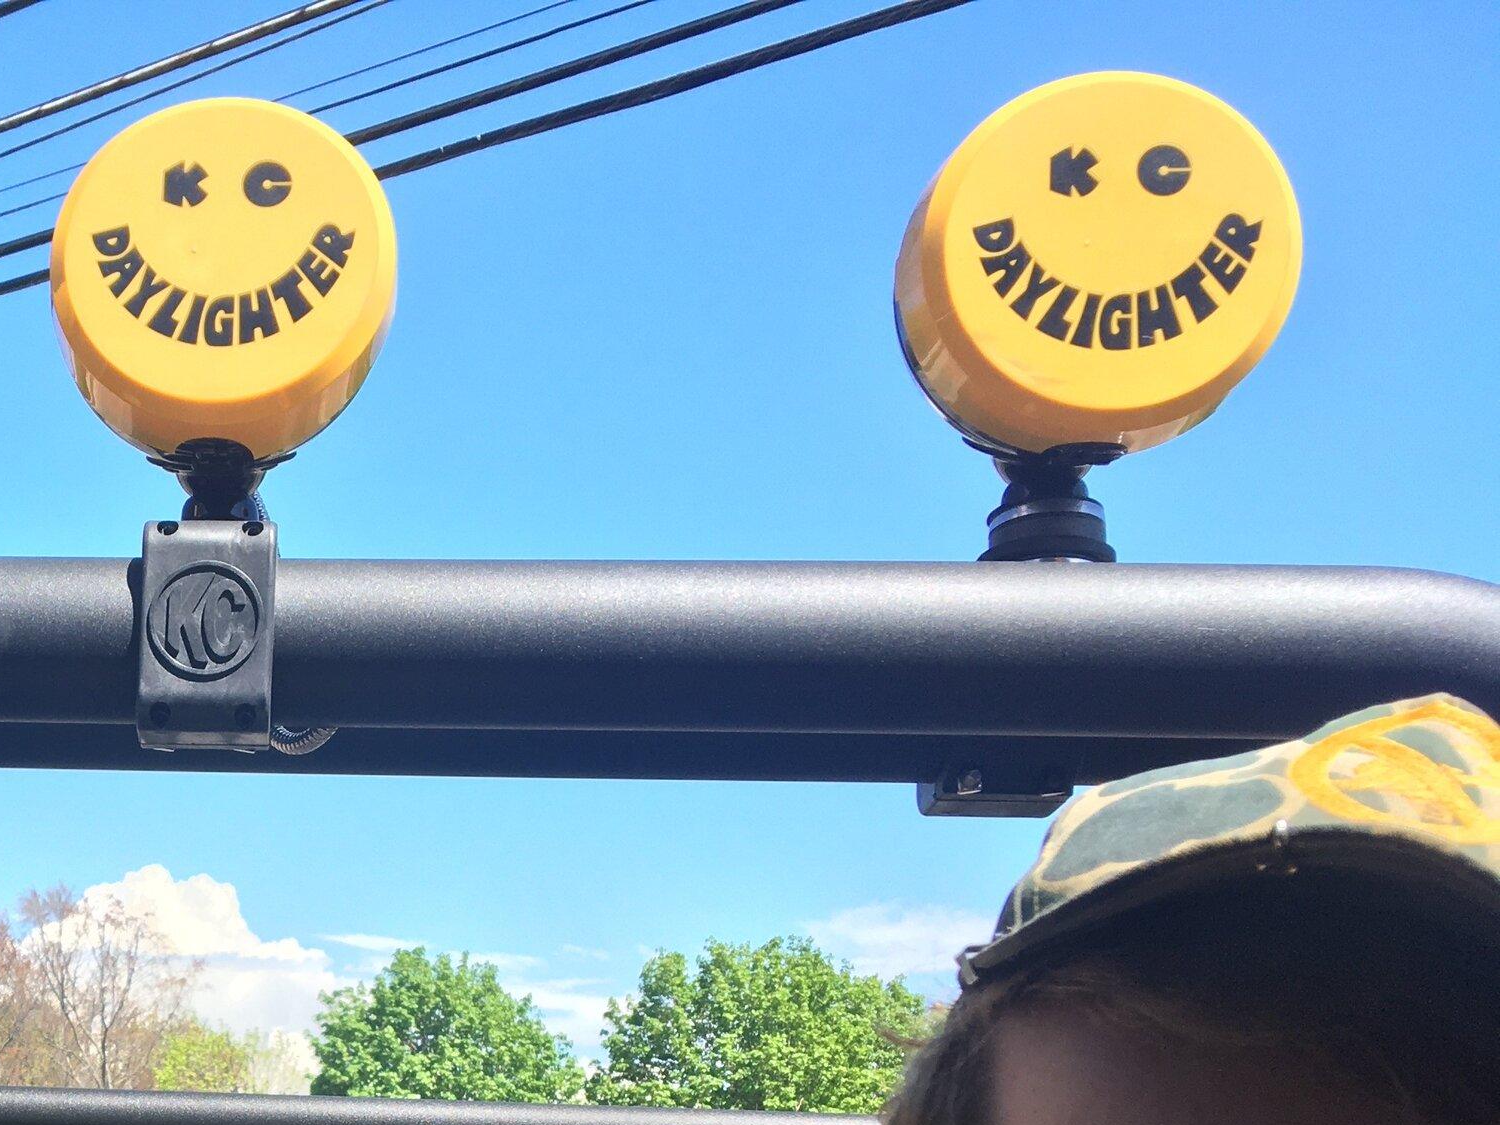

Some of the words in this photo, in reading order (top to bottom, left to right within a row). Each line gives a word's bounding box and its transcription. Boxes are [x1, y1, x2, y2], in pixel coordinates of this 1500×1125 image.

[91, 222, 356, 347] DAYLIGHTER
[972, 212, 1263, 350] DAYLIGHTER
[162, 572, 252, 669] KC
